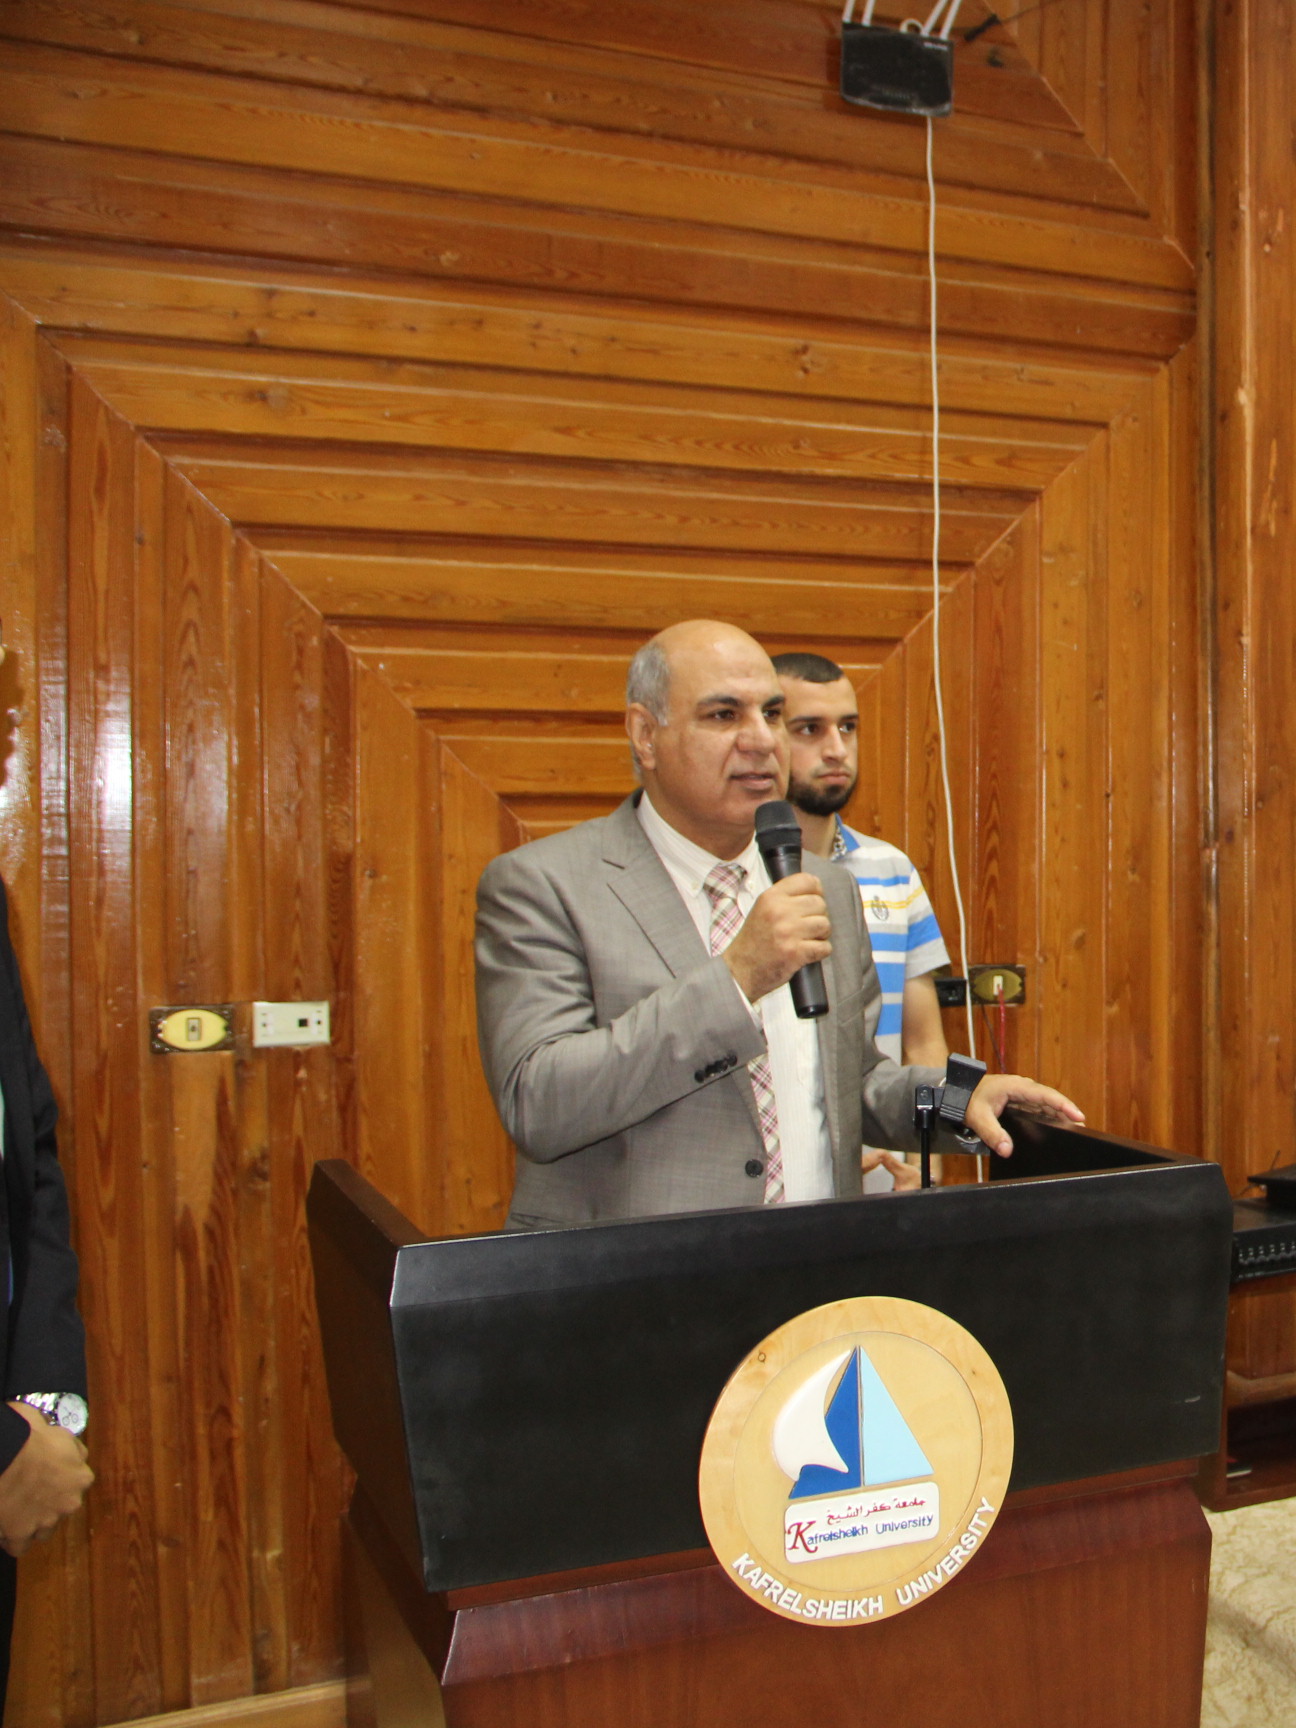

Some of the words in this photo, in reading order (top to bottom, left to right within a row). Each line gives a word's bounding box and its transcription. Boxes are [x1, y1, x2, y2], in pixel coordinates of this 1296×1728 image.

[865, 1502, 892, 1517] كفر
[894, 1497, 926, 1510] جامعة
[826, 1505, 863, 1525] الشيخ
[875, 1514, 934, 1534] University
[732, 1553, 884, 1620] KAFRELSHEIKH
[895, 1497, 996, 1606] UNIVERSITY
